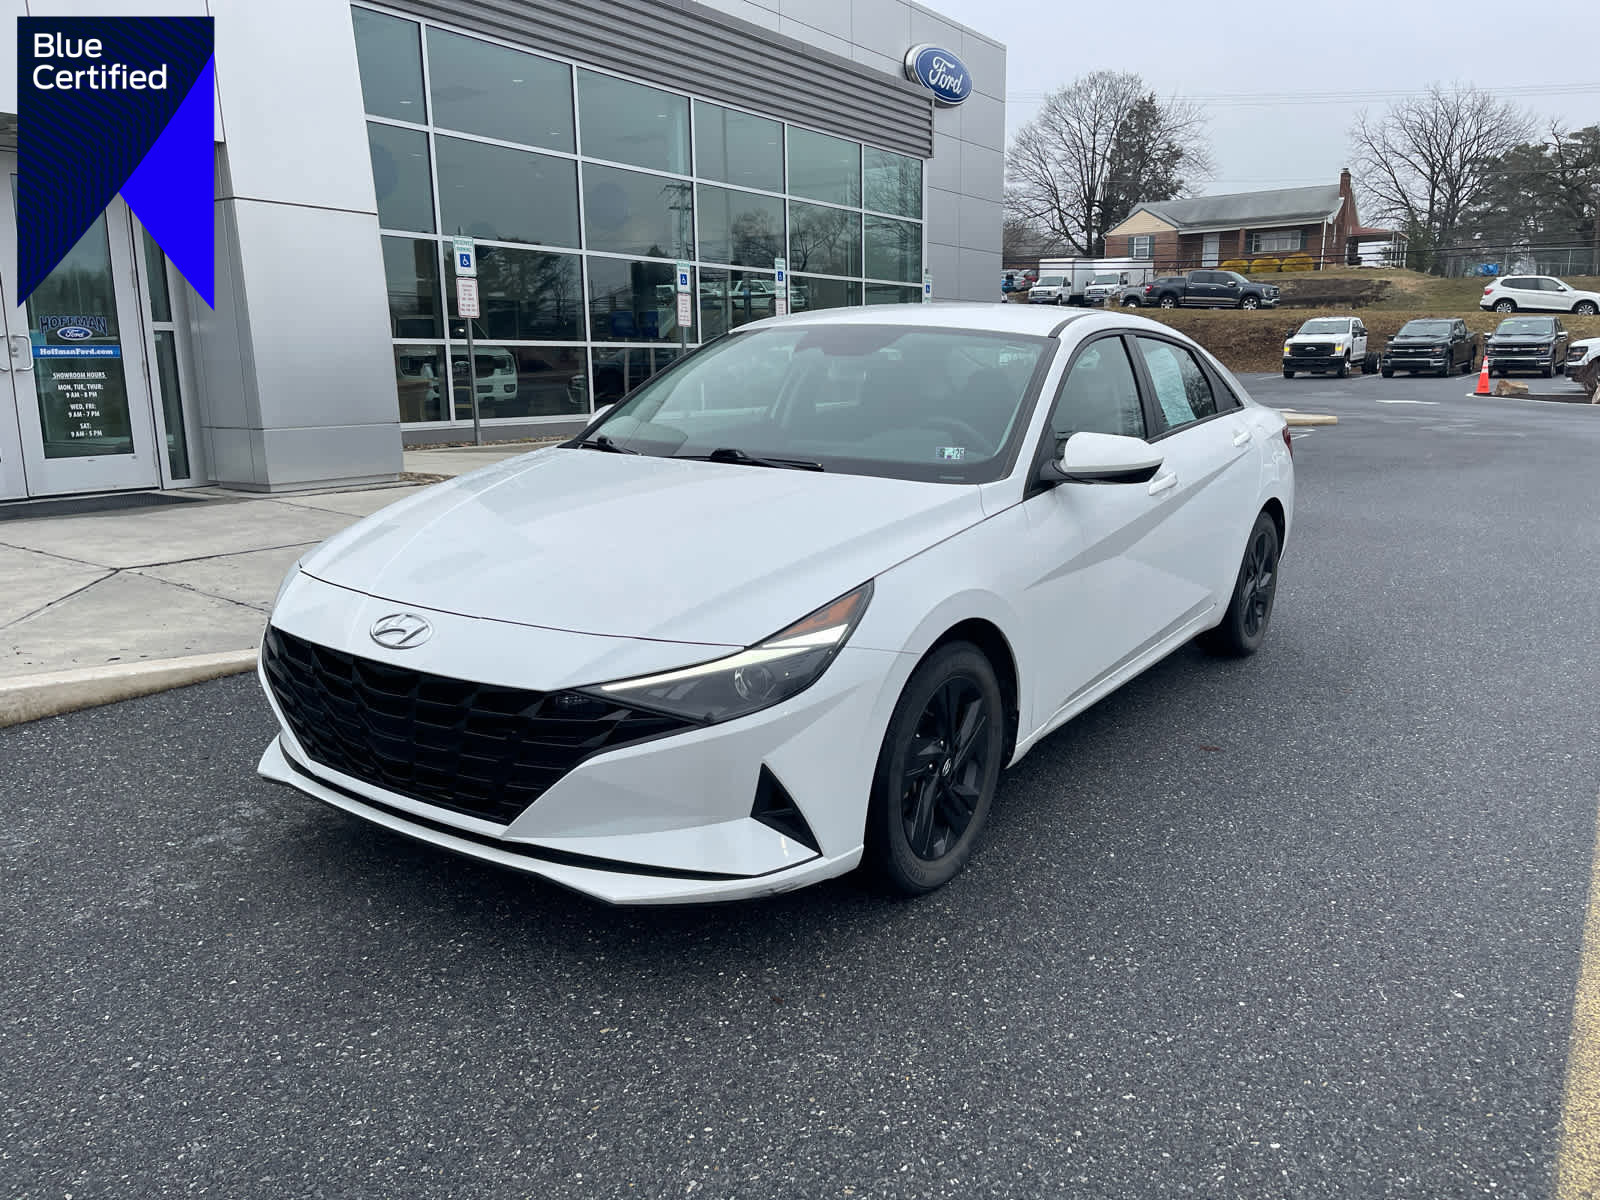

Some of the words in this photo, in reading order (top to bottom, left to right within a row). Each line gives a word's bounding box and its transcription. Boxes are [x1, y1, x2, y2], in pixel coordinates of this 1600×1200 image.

[929, 56, 963, 94] Ford
[40, 315, 108, 336] HOFFMAN
[65, 329, 84, 338] Ford
[39, 348, 114, 356] HoffmanFord.com
[52, 371, 85, 379] SHOWROOM
